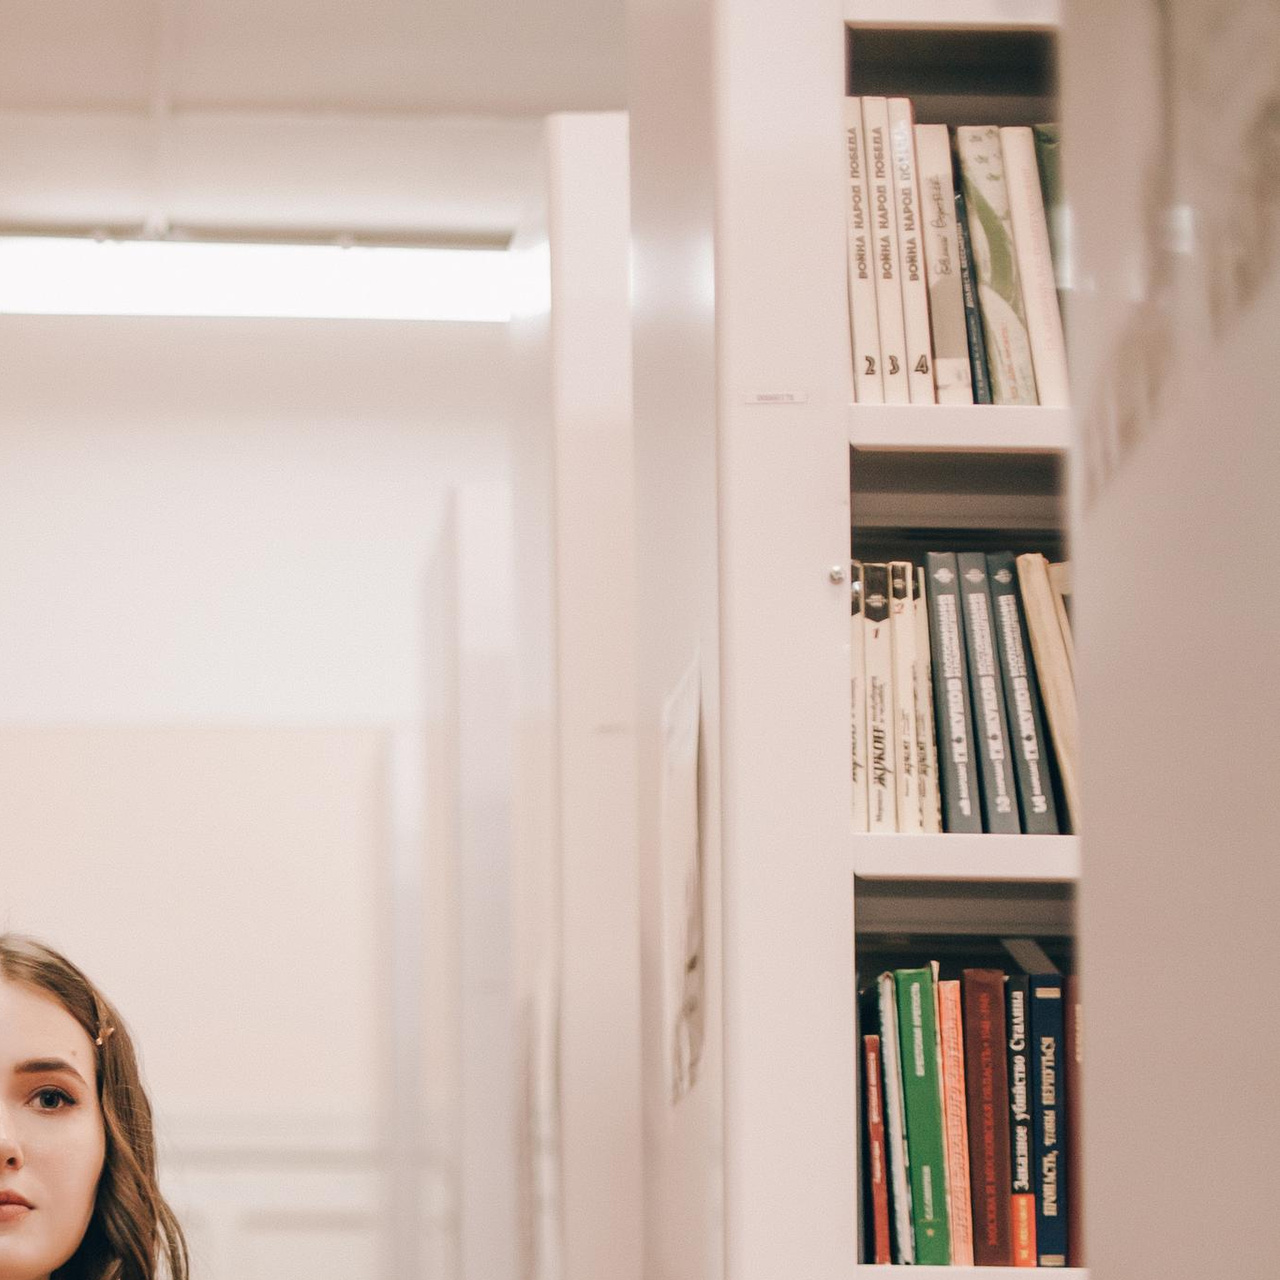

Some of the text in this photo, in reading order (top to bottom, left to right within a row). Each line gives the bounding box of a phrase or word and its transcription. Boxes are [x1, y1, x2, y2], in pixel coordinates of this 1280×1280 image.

[876, 185, 888, 231] НАРОД
[902, 187, 914, 233] НАРОД
[880, 234, 893, 280] ВОЙНА
[906, 237, 921, 282] ВОЙНА
[864, 355, 876, 375] 2
[889, 355, 900, 375] 3
[915, 354, 929, 375] 4
[1009, 990, 1025, 1051] Сталина
[1011, 1053, 1032, 1120] убийство
[1013, 1125, 1029, 1192] Заказное
